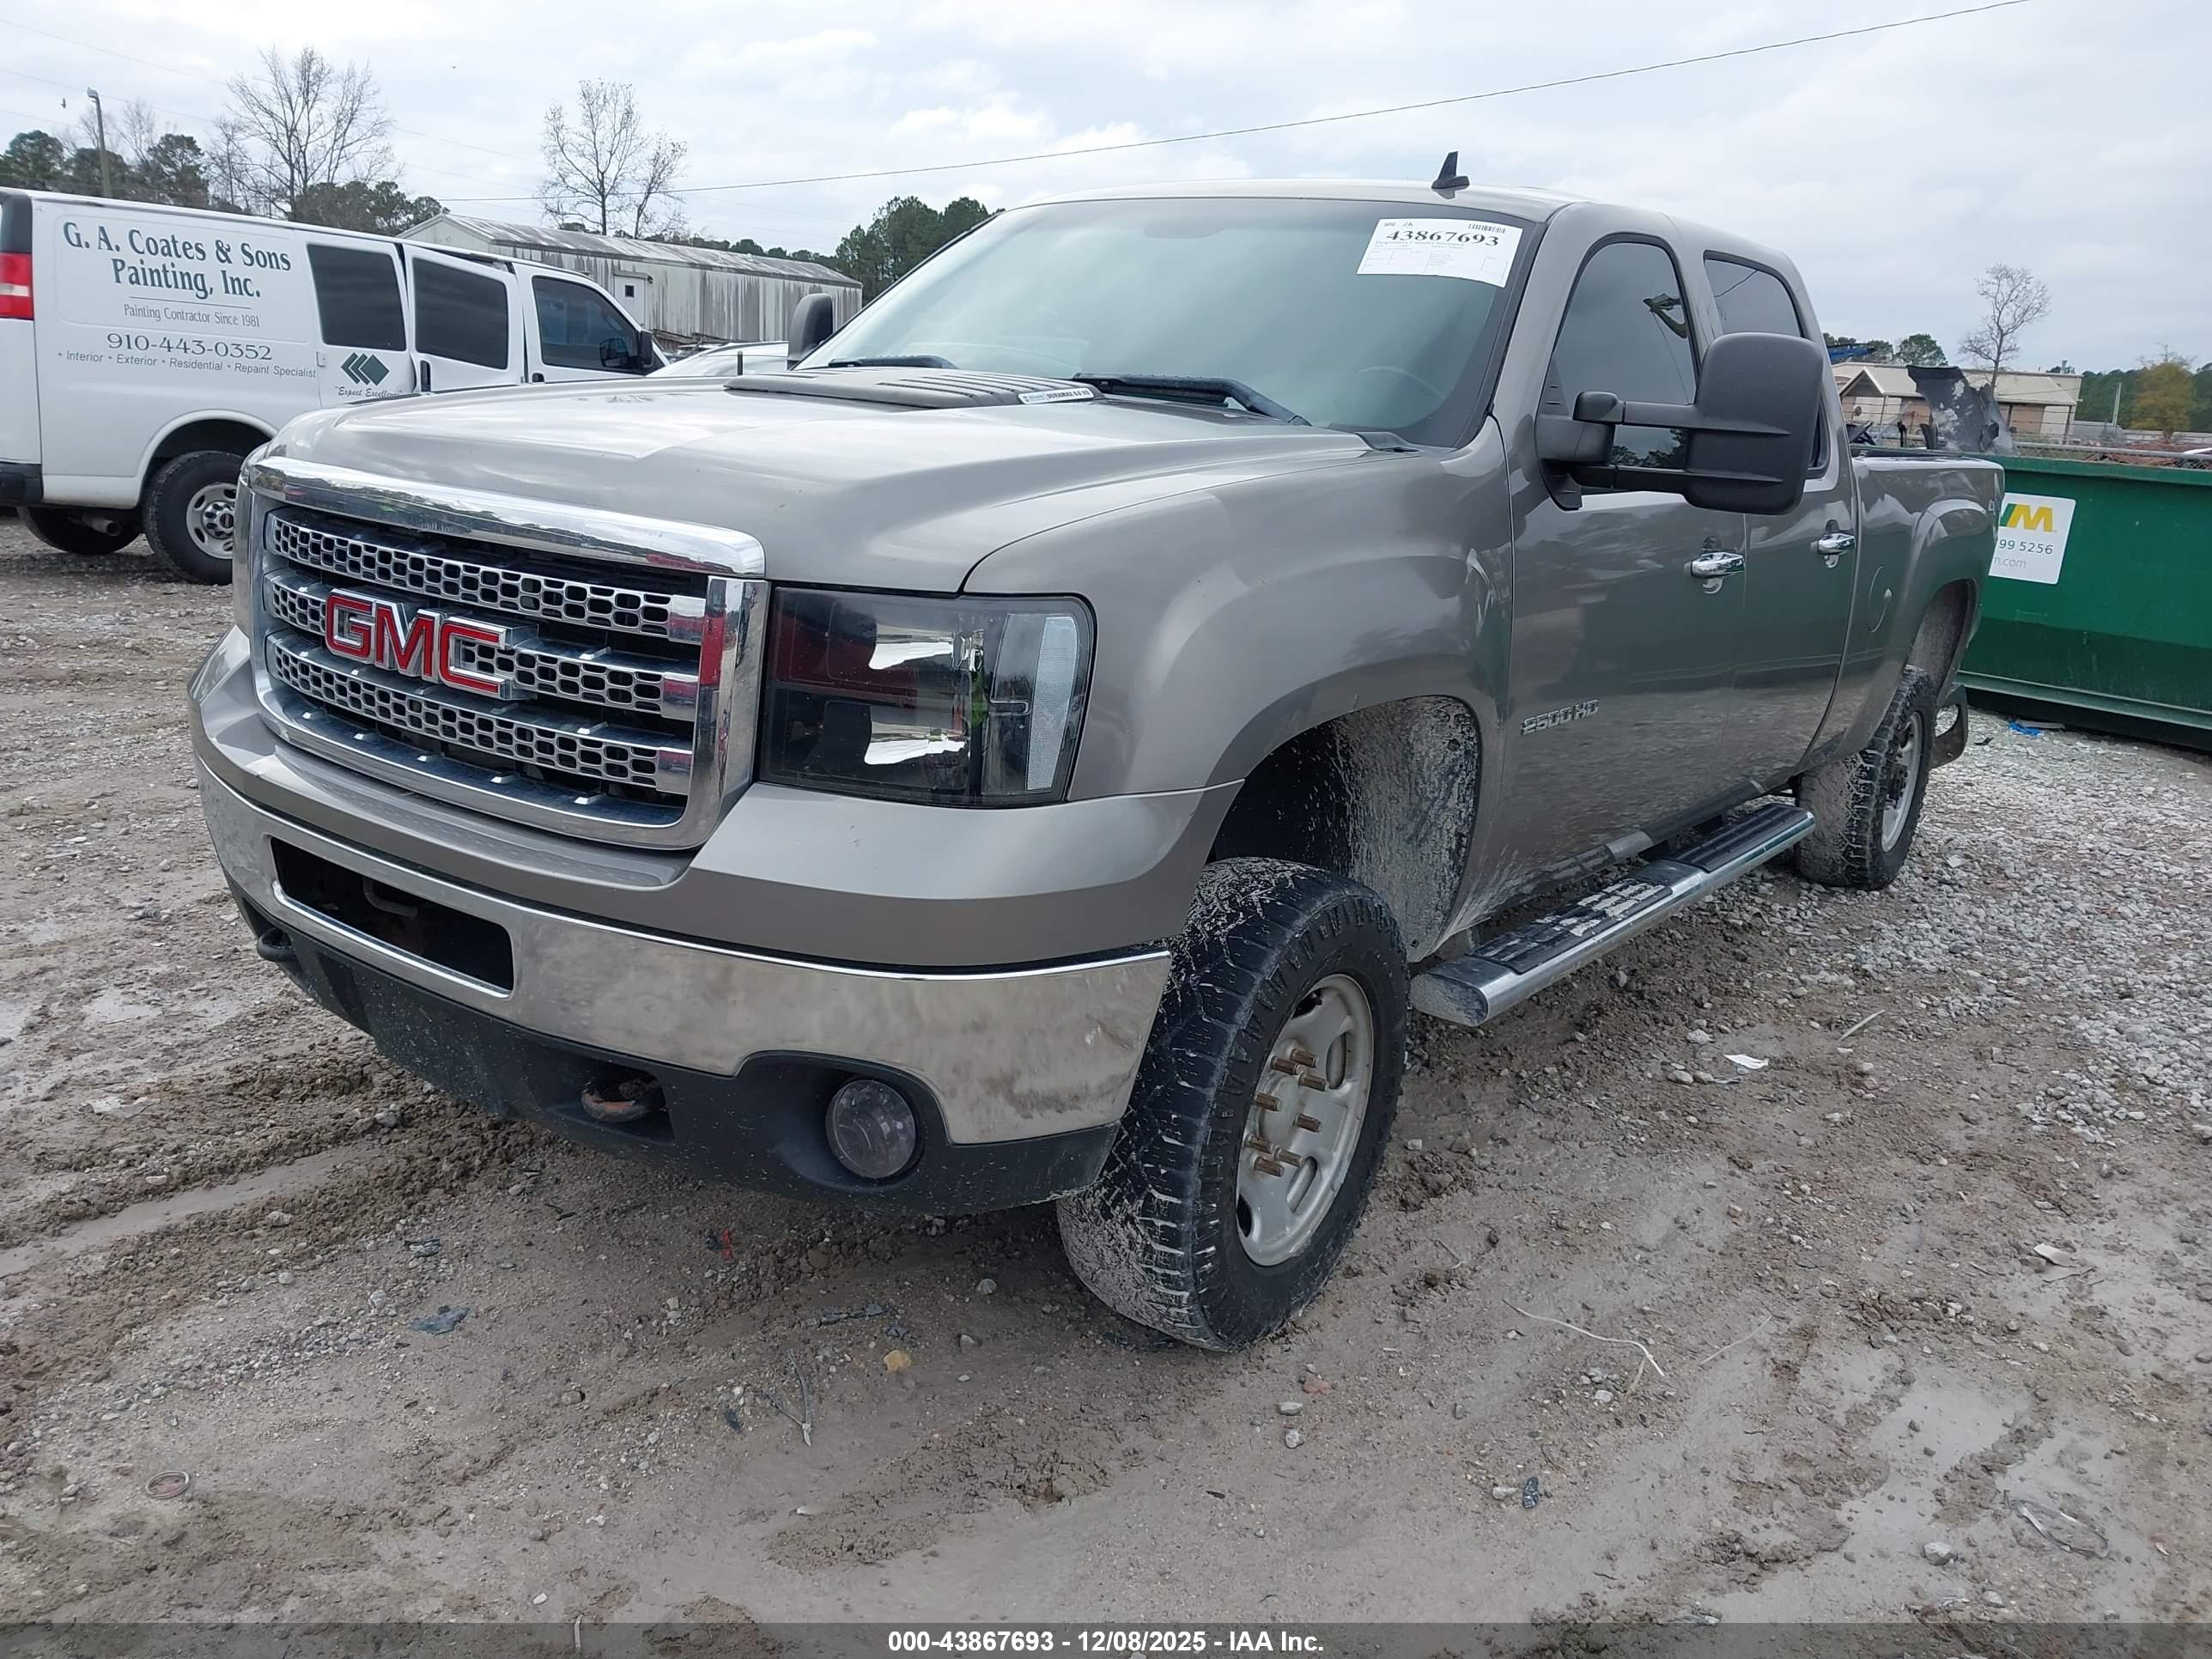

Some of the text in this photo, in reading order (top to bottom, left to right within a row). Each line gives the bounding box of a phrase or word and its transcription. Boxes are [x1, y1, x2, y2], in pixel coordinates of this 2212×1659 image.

[63, 221, 291, 271] G. A. Coates & Sons
[1386, 229, 1500, 247] 43867693
[111, 258, 261, 300] Painting, Inc.
[124, 303, 259, 327] Painting Contractor Since 1981
[106, 331, 272, 361] 910-443-0352
[66, 349, 316, 379] Interior Exterior Residential Repaint Specialist
[1998, 538, 2054, 556] 99 5256
[1992, 556, 2027, 569] m.com
[325, 588, 510, 699] GMC
